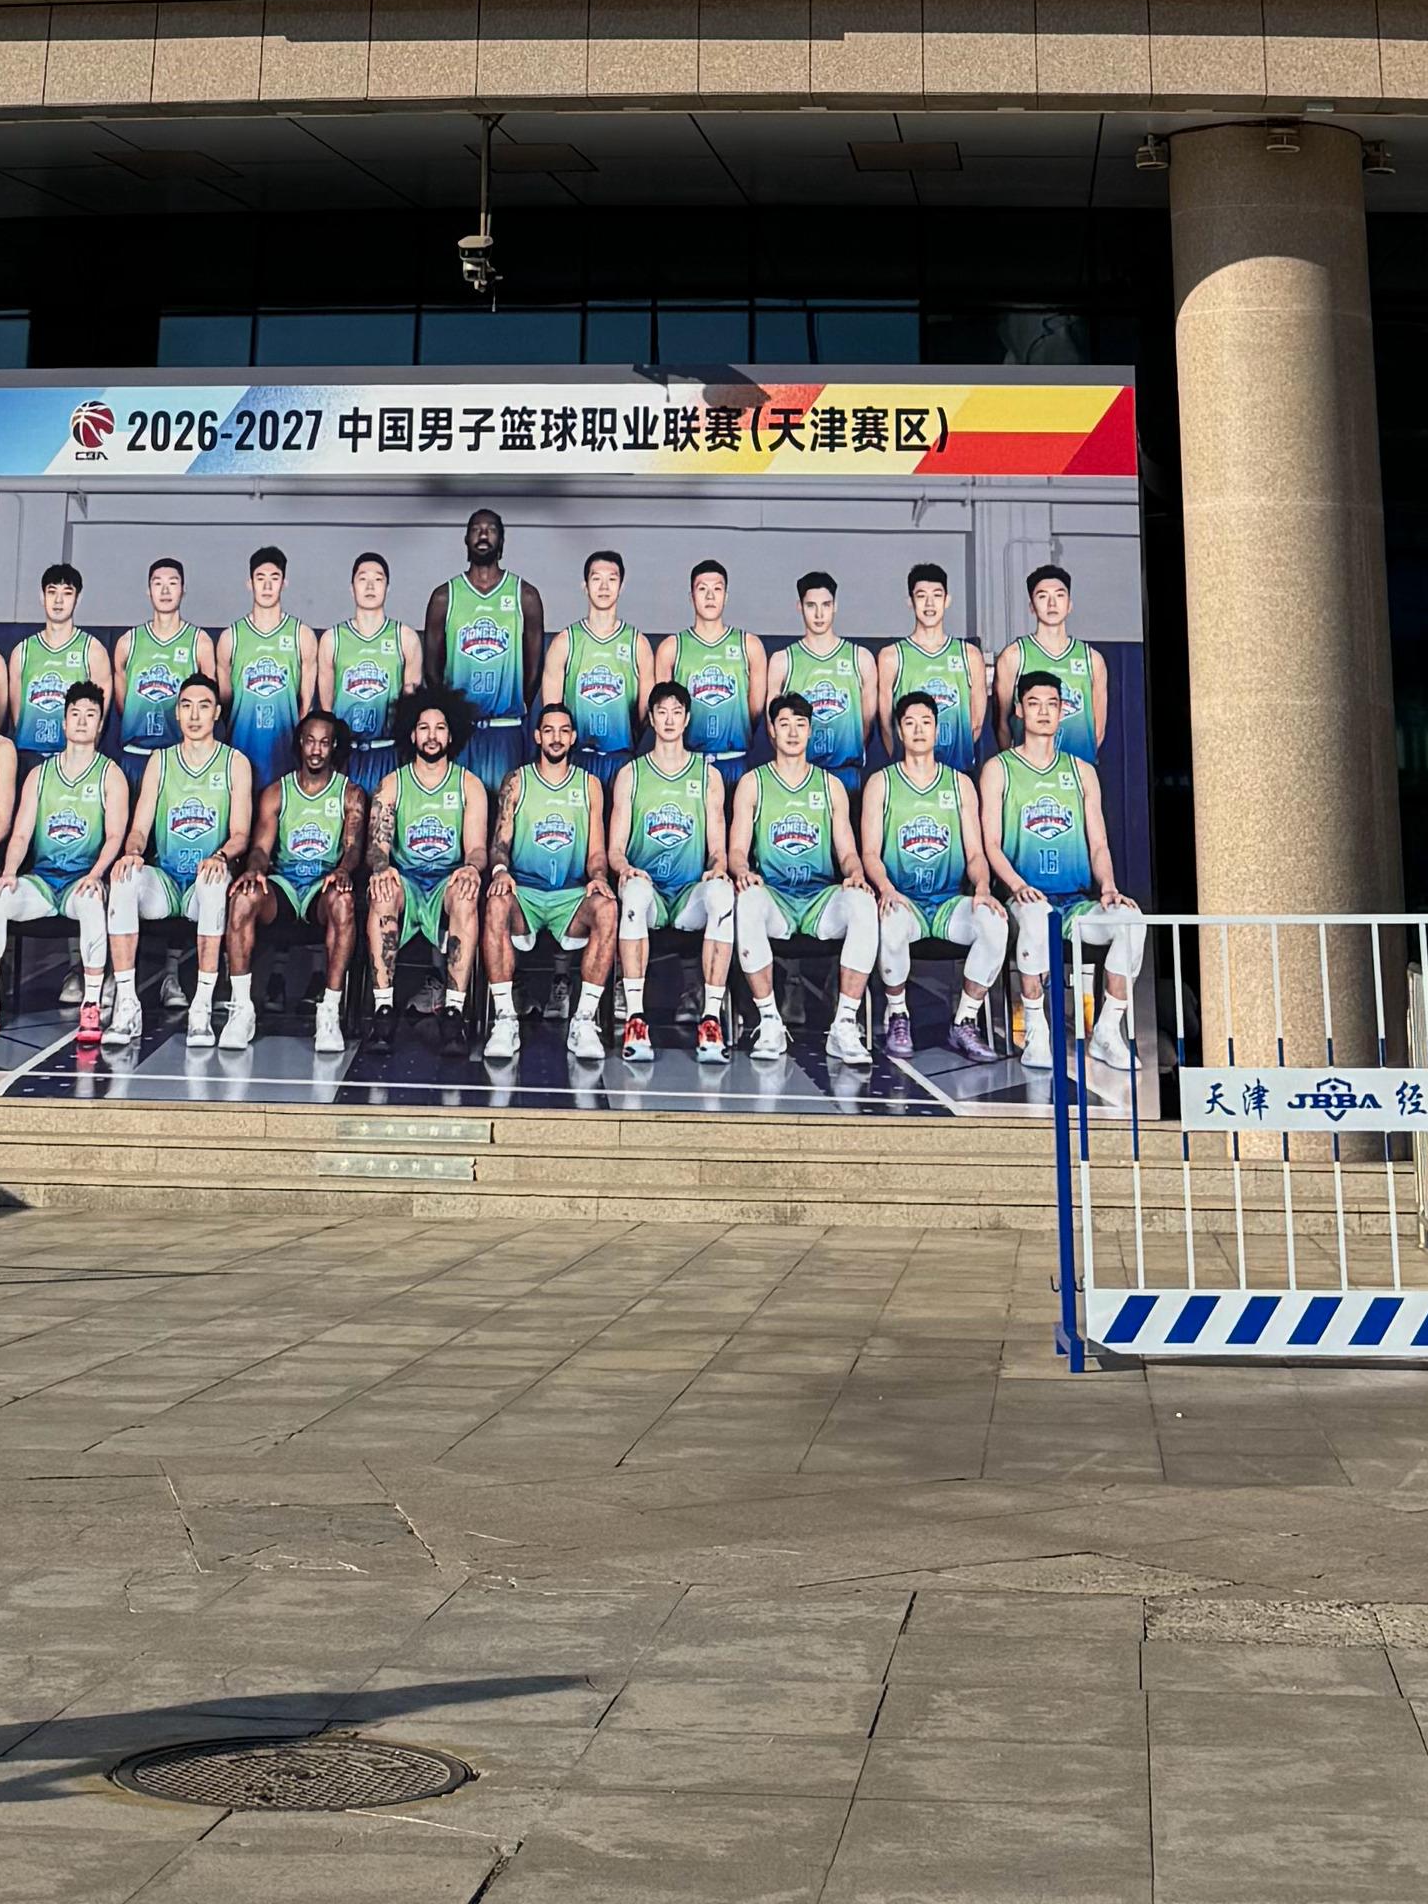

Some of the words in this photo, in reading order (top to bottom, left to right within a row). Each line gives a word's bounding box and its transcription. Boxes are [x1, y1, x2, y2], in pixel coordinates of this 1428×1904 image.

[126, 409, 324, 452] 2026-2027
[336, 404, 951, 456] 中国男子篮球职业联赛(天津赛区)
[1038, 848, 1060, 875] 16
[1204, 1079, 1270, 1120] 天津
